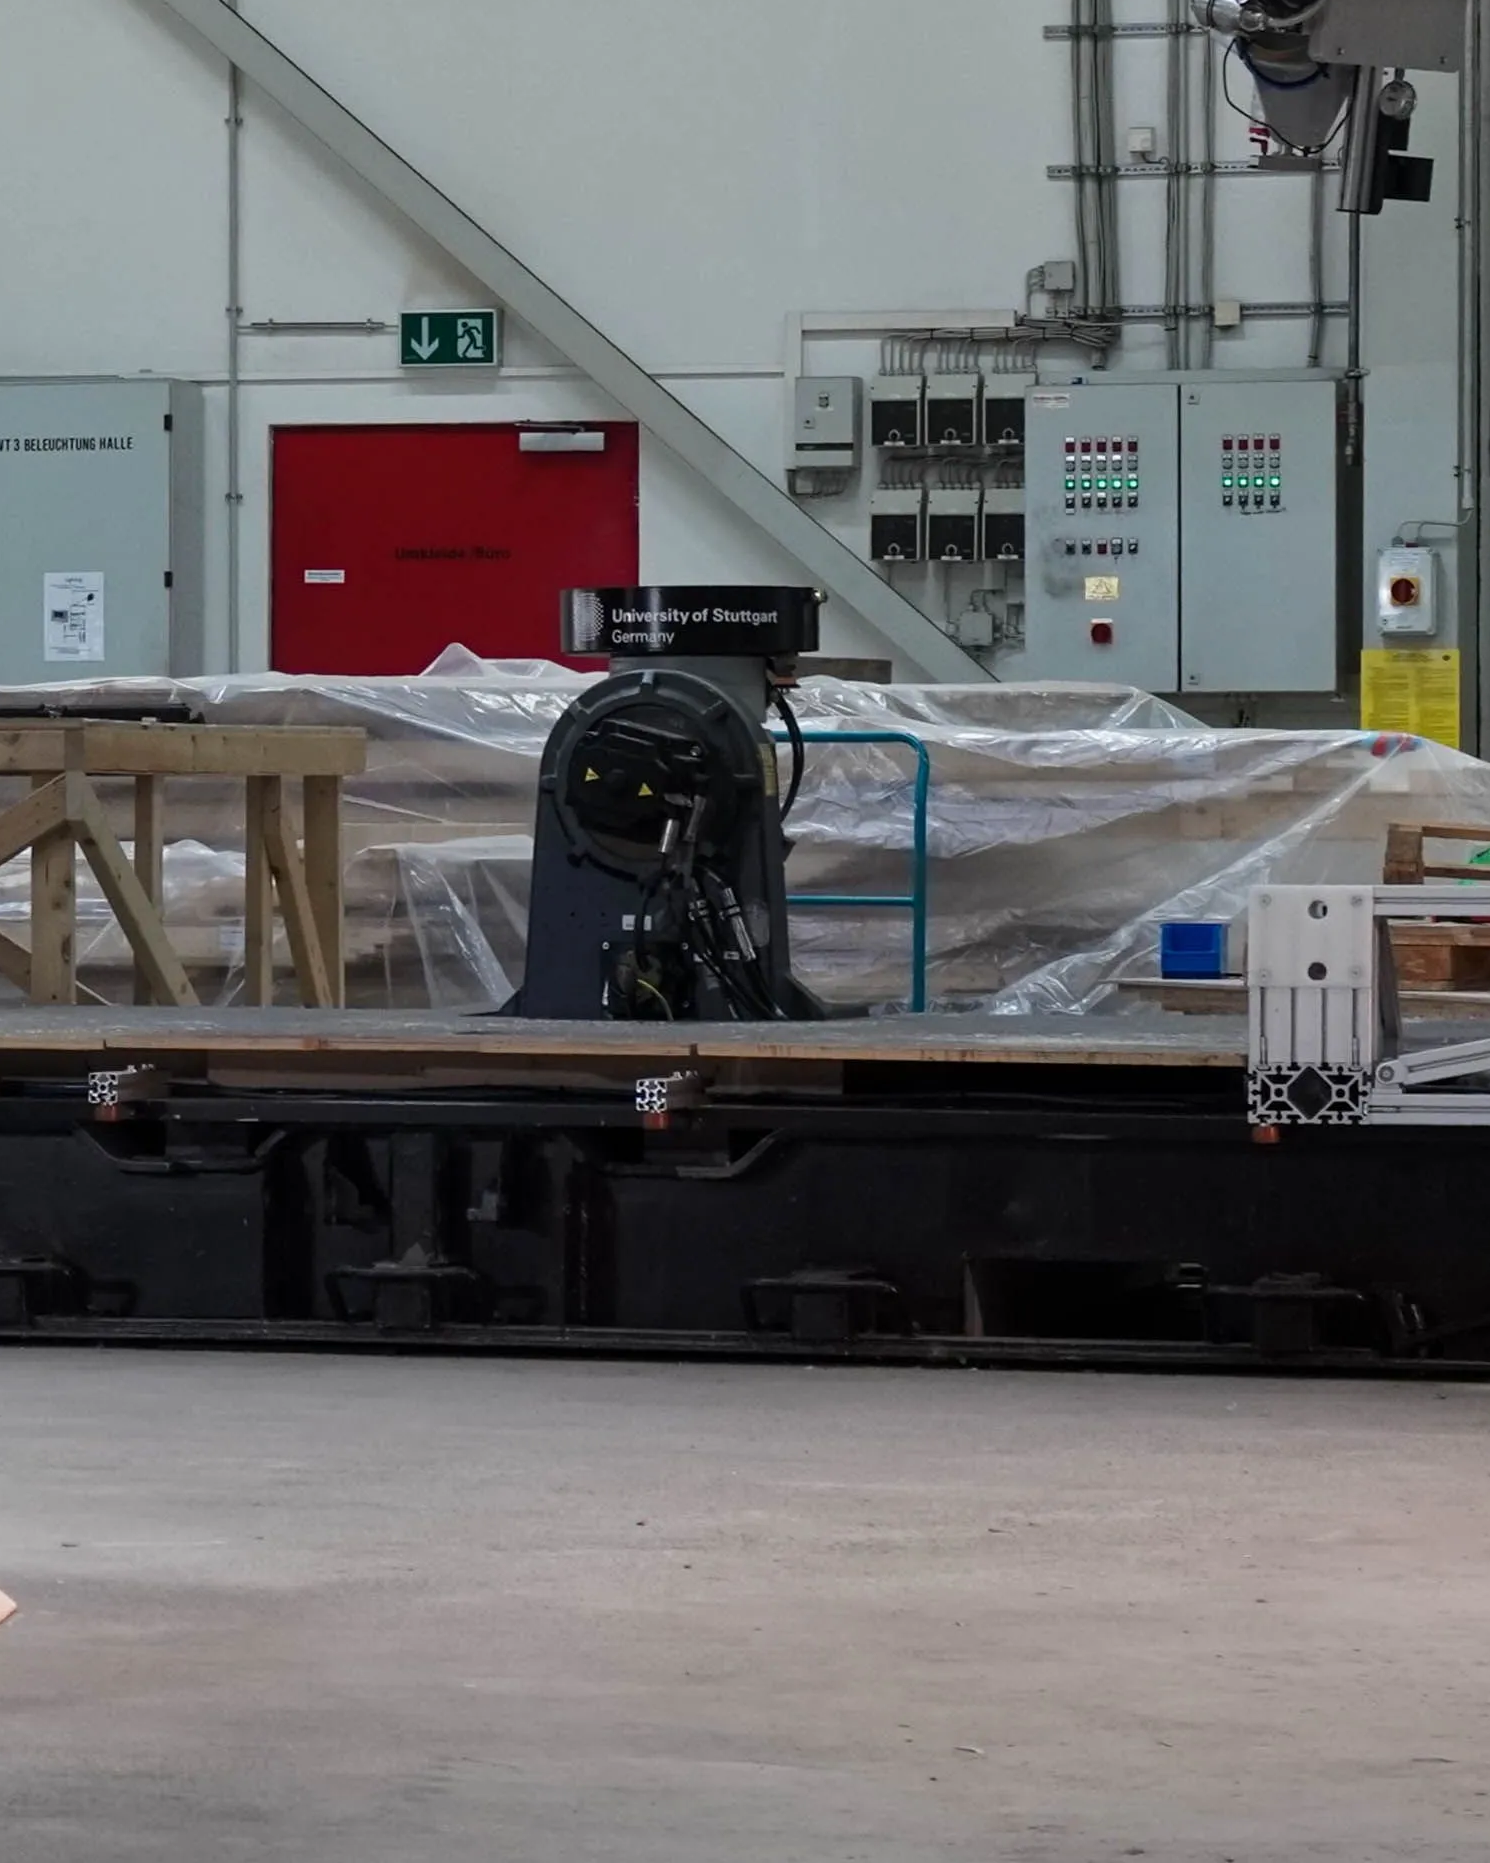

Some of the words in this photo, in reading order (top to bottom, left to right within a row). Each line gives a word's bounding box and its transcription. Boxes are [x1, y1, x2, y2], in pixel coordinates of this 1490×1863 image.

[13, 438, 20, 452] 3
[24, 437, 96, 452] BELEUCHTUNG
[99, 436, 134, 451] HALLE
[611, 608, 690, 625] University
[691, 607, 709, 622] of
[712, 607, 778, 626] Stuttgart
[611, 629, 675, 644] Germany
